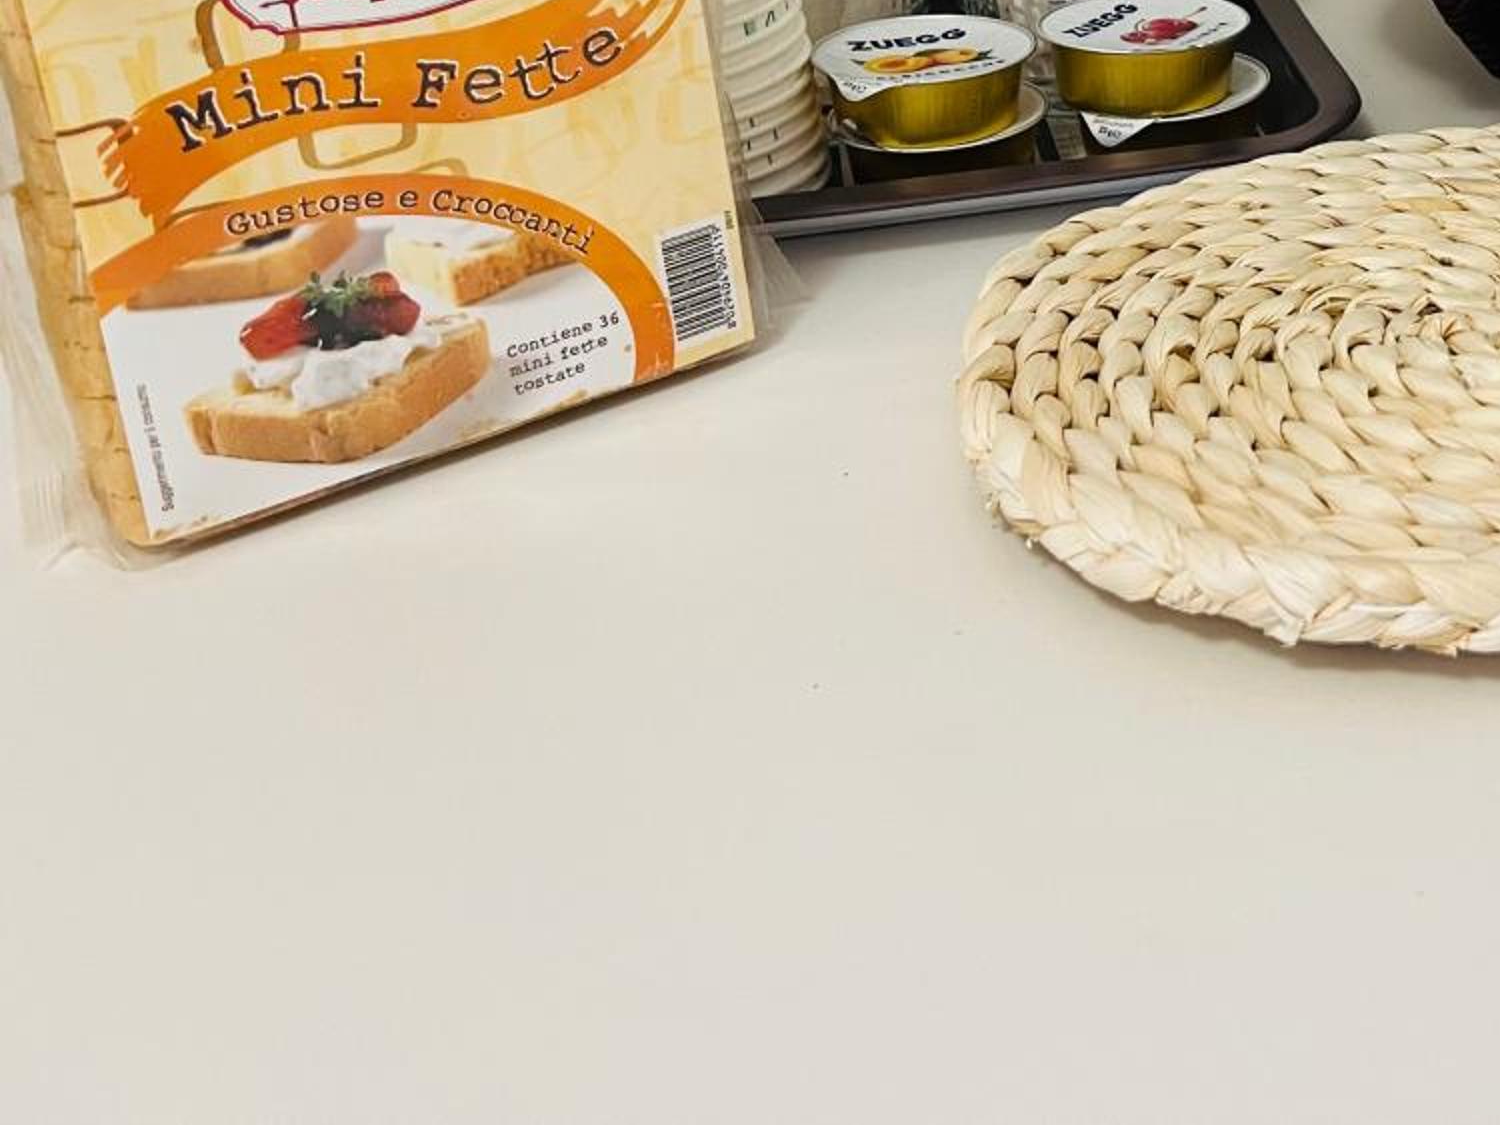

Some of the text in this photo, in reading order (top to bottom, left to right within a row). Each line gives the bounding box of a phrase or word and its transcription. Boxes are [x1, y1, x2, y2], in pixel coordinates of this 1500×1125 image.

[847, 28, 967, 52] ZUEGG
[1062, 3, 1139, 38] ZUEGG
[165, 26, 621, 153] Mini Fette
[226, 189, 595, 255] Gustose e Croccanti
[507, 311, 619, 358] Contiene 36
[509, 336, 608, 377] mini fette
[514, 362, 585, 395] tostate
